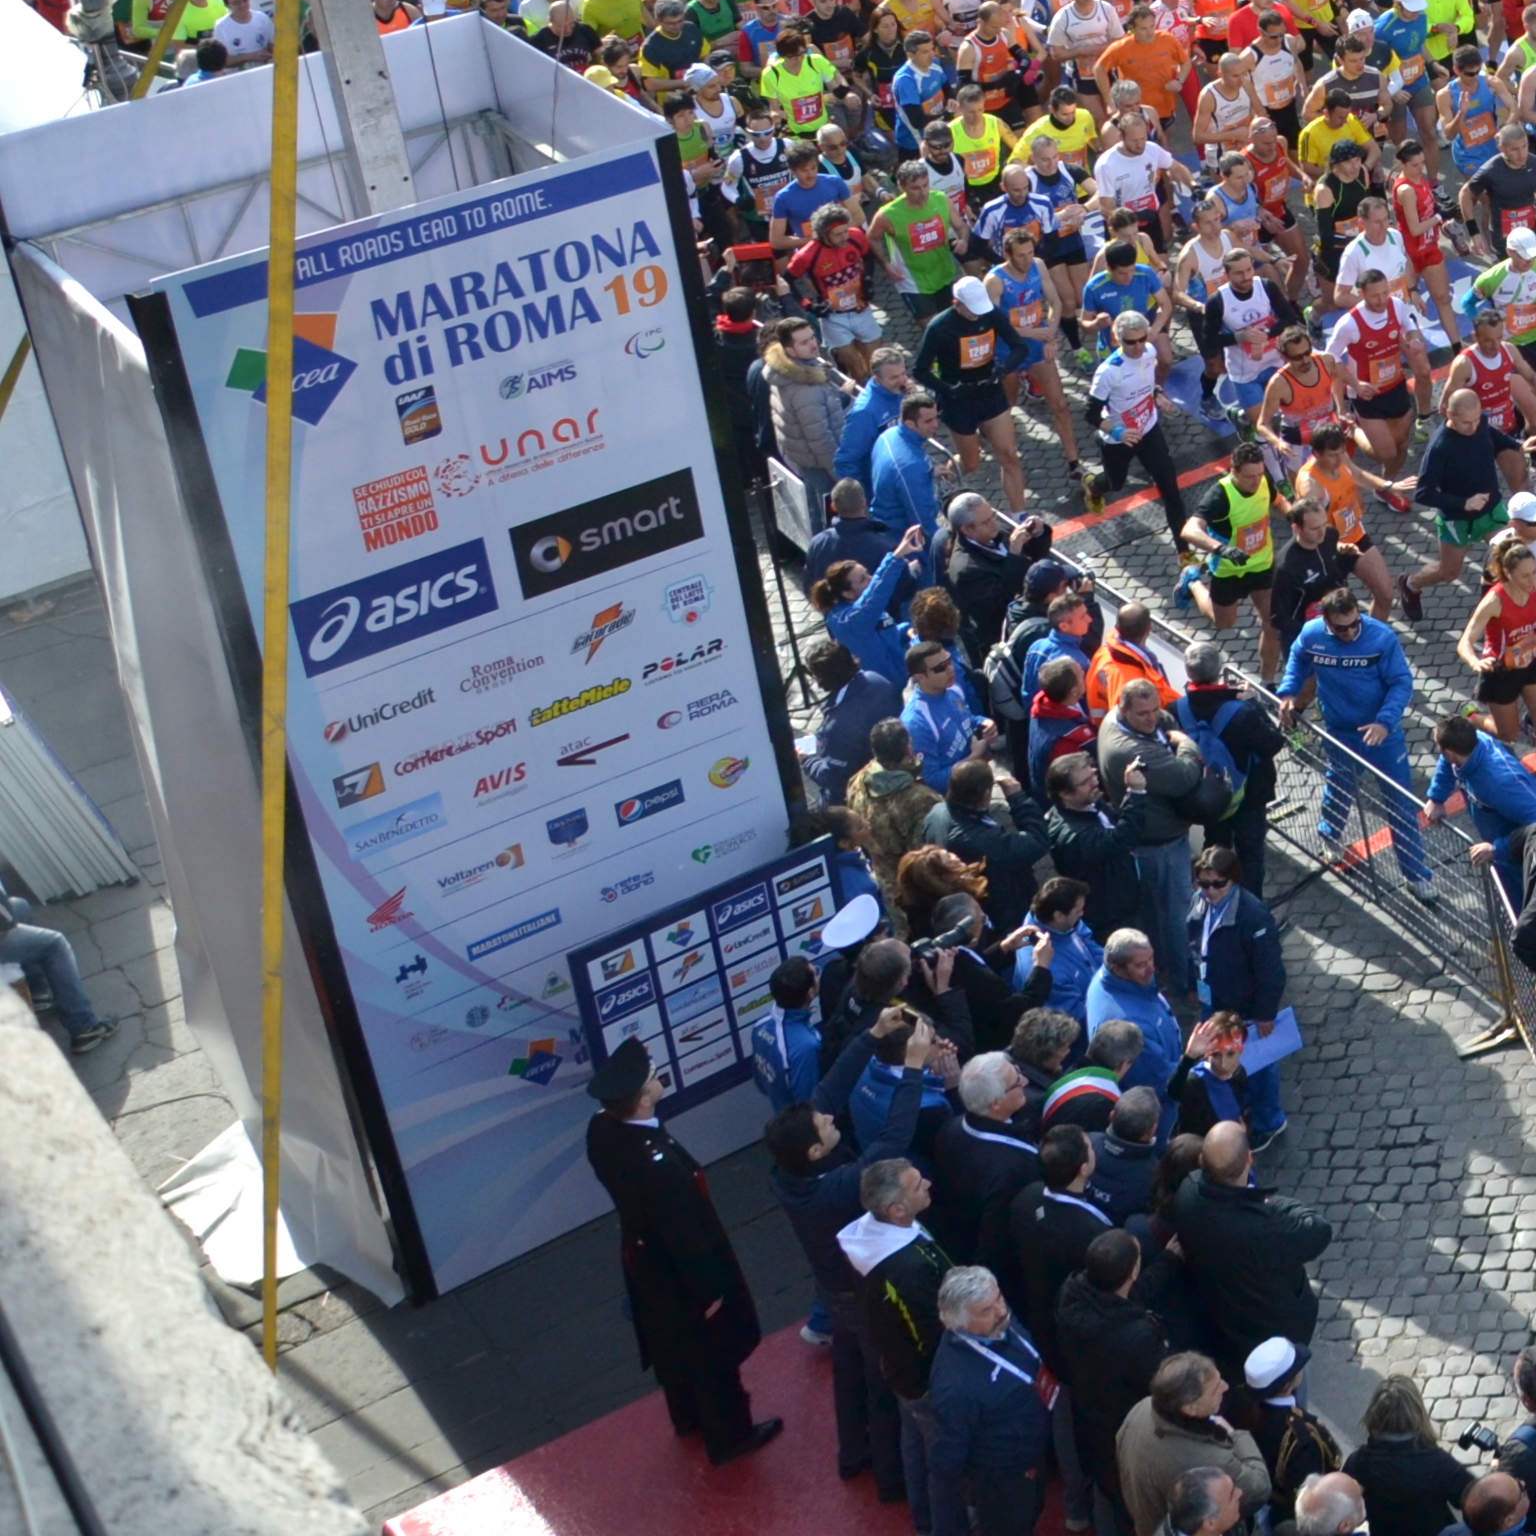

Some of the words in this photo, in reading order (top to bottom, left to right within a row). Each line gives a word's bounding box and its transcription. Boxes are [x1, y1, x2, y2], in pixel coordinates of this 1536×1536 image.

[296, 256, 334, 281] ALL
[339, 231, 403, 270] ROADS
[408, 215, 457, 247] LEAD
[461, 207, 486, 231] TO
[490, 189, 552, 225] ROME.
[919, 232, 938, 244] 288
[370, 220, 662, 341] MARATONA
[383, 335, 435, 386] di
[443, 287, 602, 368] ROMA
[604, 264, 668, 316] 19
[1513, 313, 1536, 326] 2003
[526, 365, 577, 395] AIMS
[398, 389, 426, 406] IAAF
[480, 408, 599, 466] unar
[487, 477, 495, 487] A
[499, 468, 529, 483] difesa
[531, 458, 555, 474] delle
[557, 441, 605, 465] differenze
[354, 485, 370, 500] SE
[371, 472, 405, 496] CHIUDI
[407, 466, 427, 484] COL
[357, 479, 429, 516] RAZZISMO
[361, 517, 375, 530] TI
[375, 513, 386, 526] SI
[386, 504, 415, 524] APRE
[416, 497, 433, 513] UN
[579, 496, 684, 552] smart
[363, 510, 439, 553] MONDO
[365, 564, 479, 633] asics
[573, 609, 636, 651] Gatorade
[459, 654, 545, 694] Convention
[471, 654, 514, 678] Roma
[642, 638, 723, 679] POLAR
[348, 687, 436, 733] UniCredit
[529, 677, 631, 728] LatteMiele
[687, 689, 731, 712] FIERA
[689, 697, 739, 721] ROMA
[560, 736, 592, 756] atac
[473, 762, 526, 798] AVIS
[644, 787, 679, 810] pepsi
[437, 860, 494, 888] Voltaren
[620, 876, 655, 895] dono
[792, 867, 821, 886] smart
[733, 892, 765, 916] asics
[369, 910, 416, 934] HONDA
[734, 927, 771, 950] UniCredit
[616, 981, 649, 1005] asics
